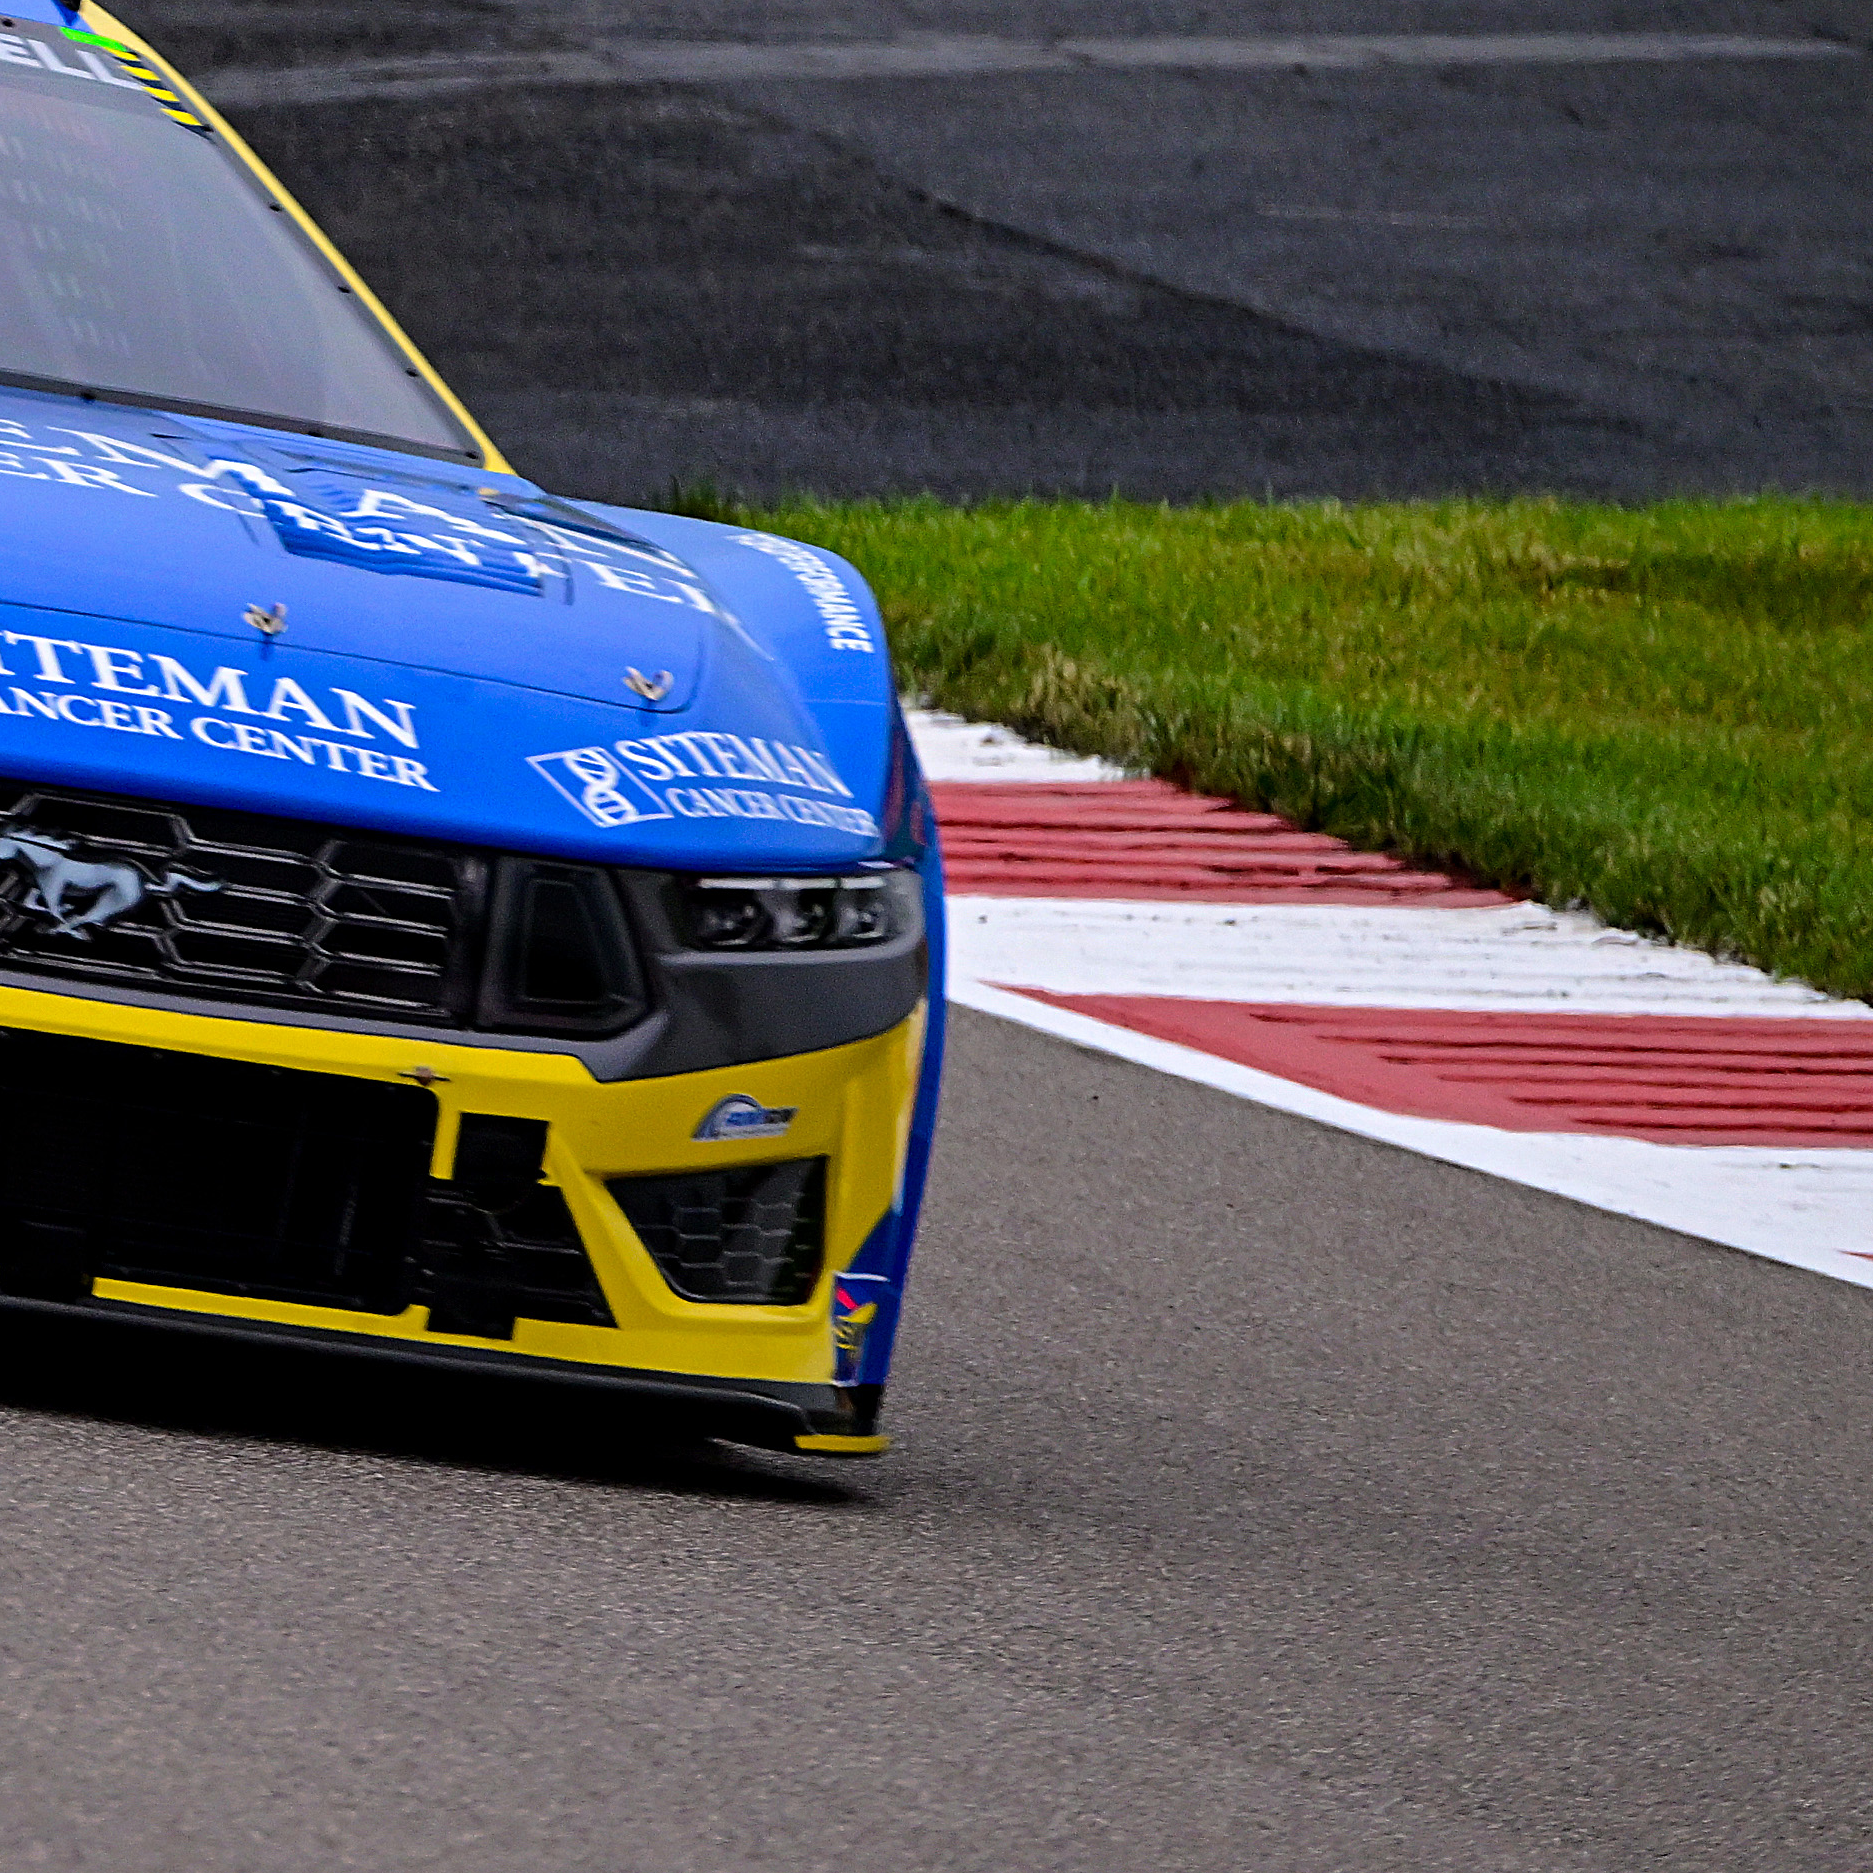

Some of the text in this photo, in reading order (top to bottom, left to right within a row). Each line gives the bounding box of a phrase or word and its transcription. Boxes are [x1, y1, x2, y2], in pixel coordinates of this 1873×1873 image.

[191, 717, 441, 793] CENTER
[614, 731, 855, 799] SITEMAN
[665, 788, 787, 820] CANCER
